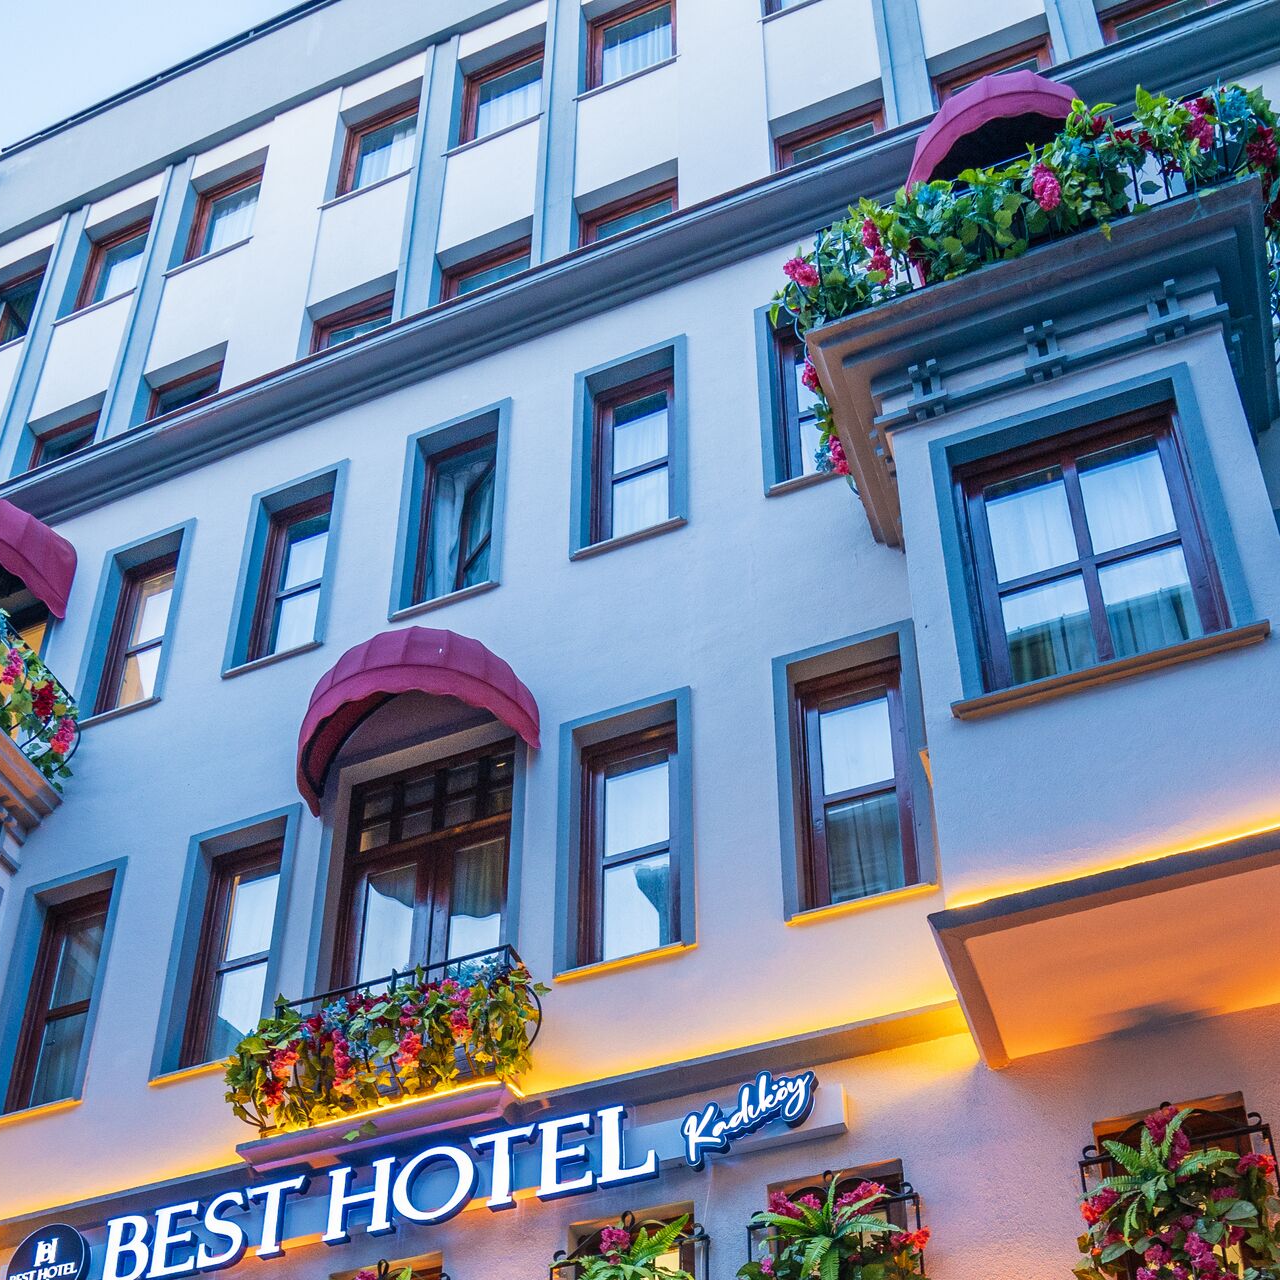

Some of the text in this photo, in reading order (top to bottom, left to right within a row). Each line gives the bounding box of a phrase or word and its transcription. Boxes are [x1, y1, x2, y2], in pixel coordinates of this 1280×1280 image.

[324, 1105, 659, 1244] HOTEL
[682, 1068, 817, 1170] Kadıköy
[37, 1262, 77, 1280] HOTEL
